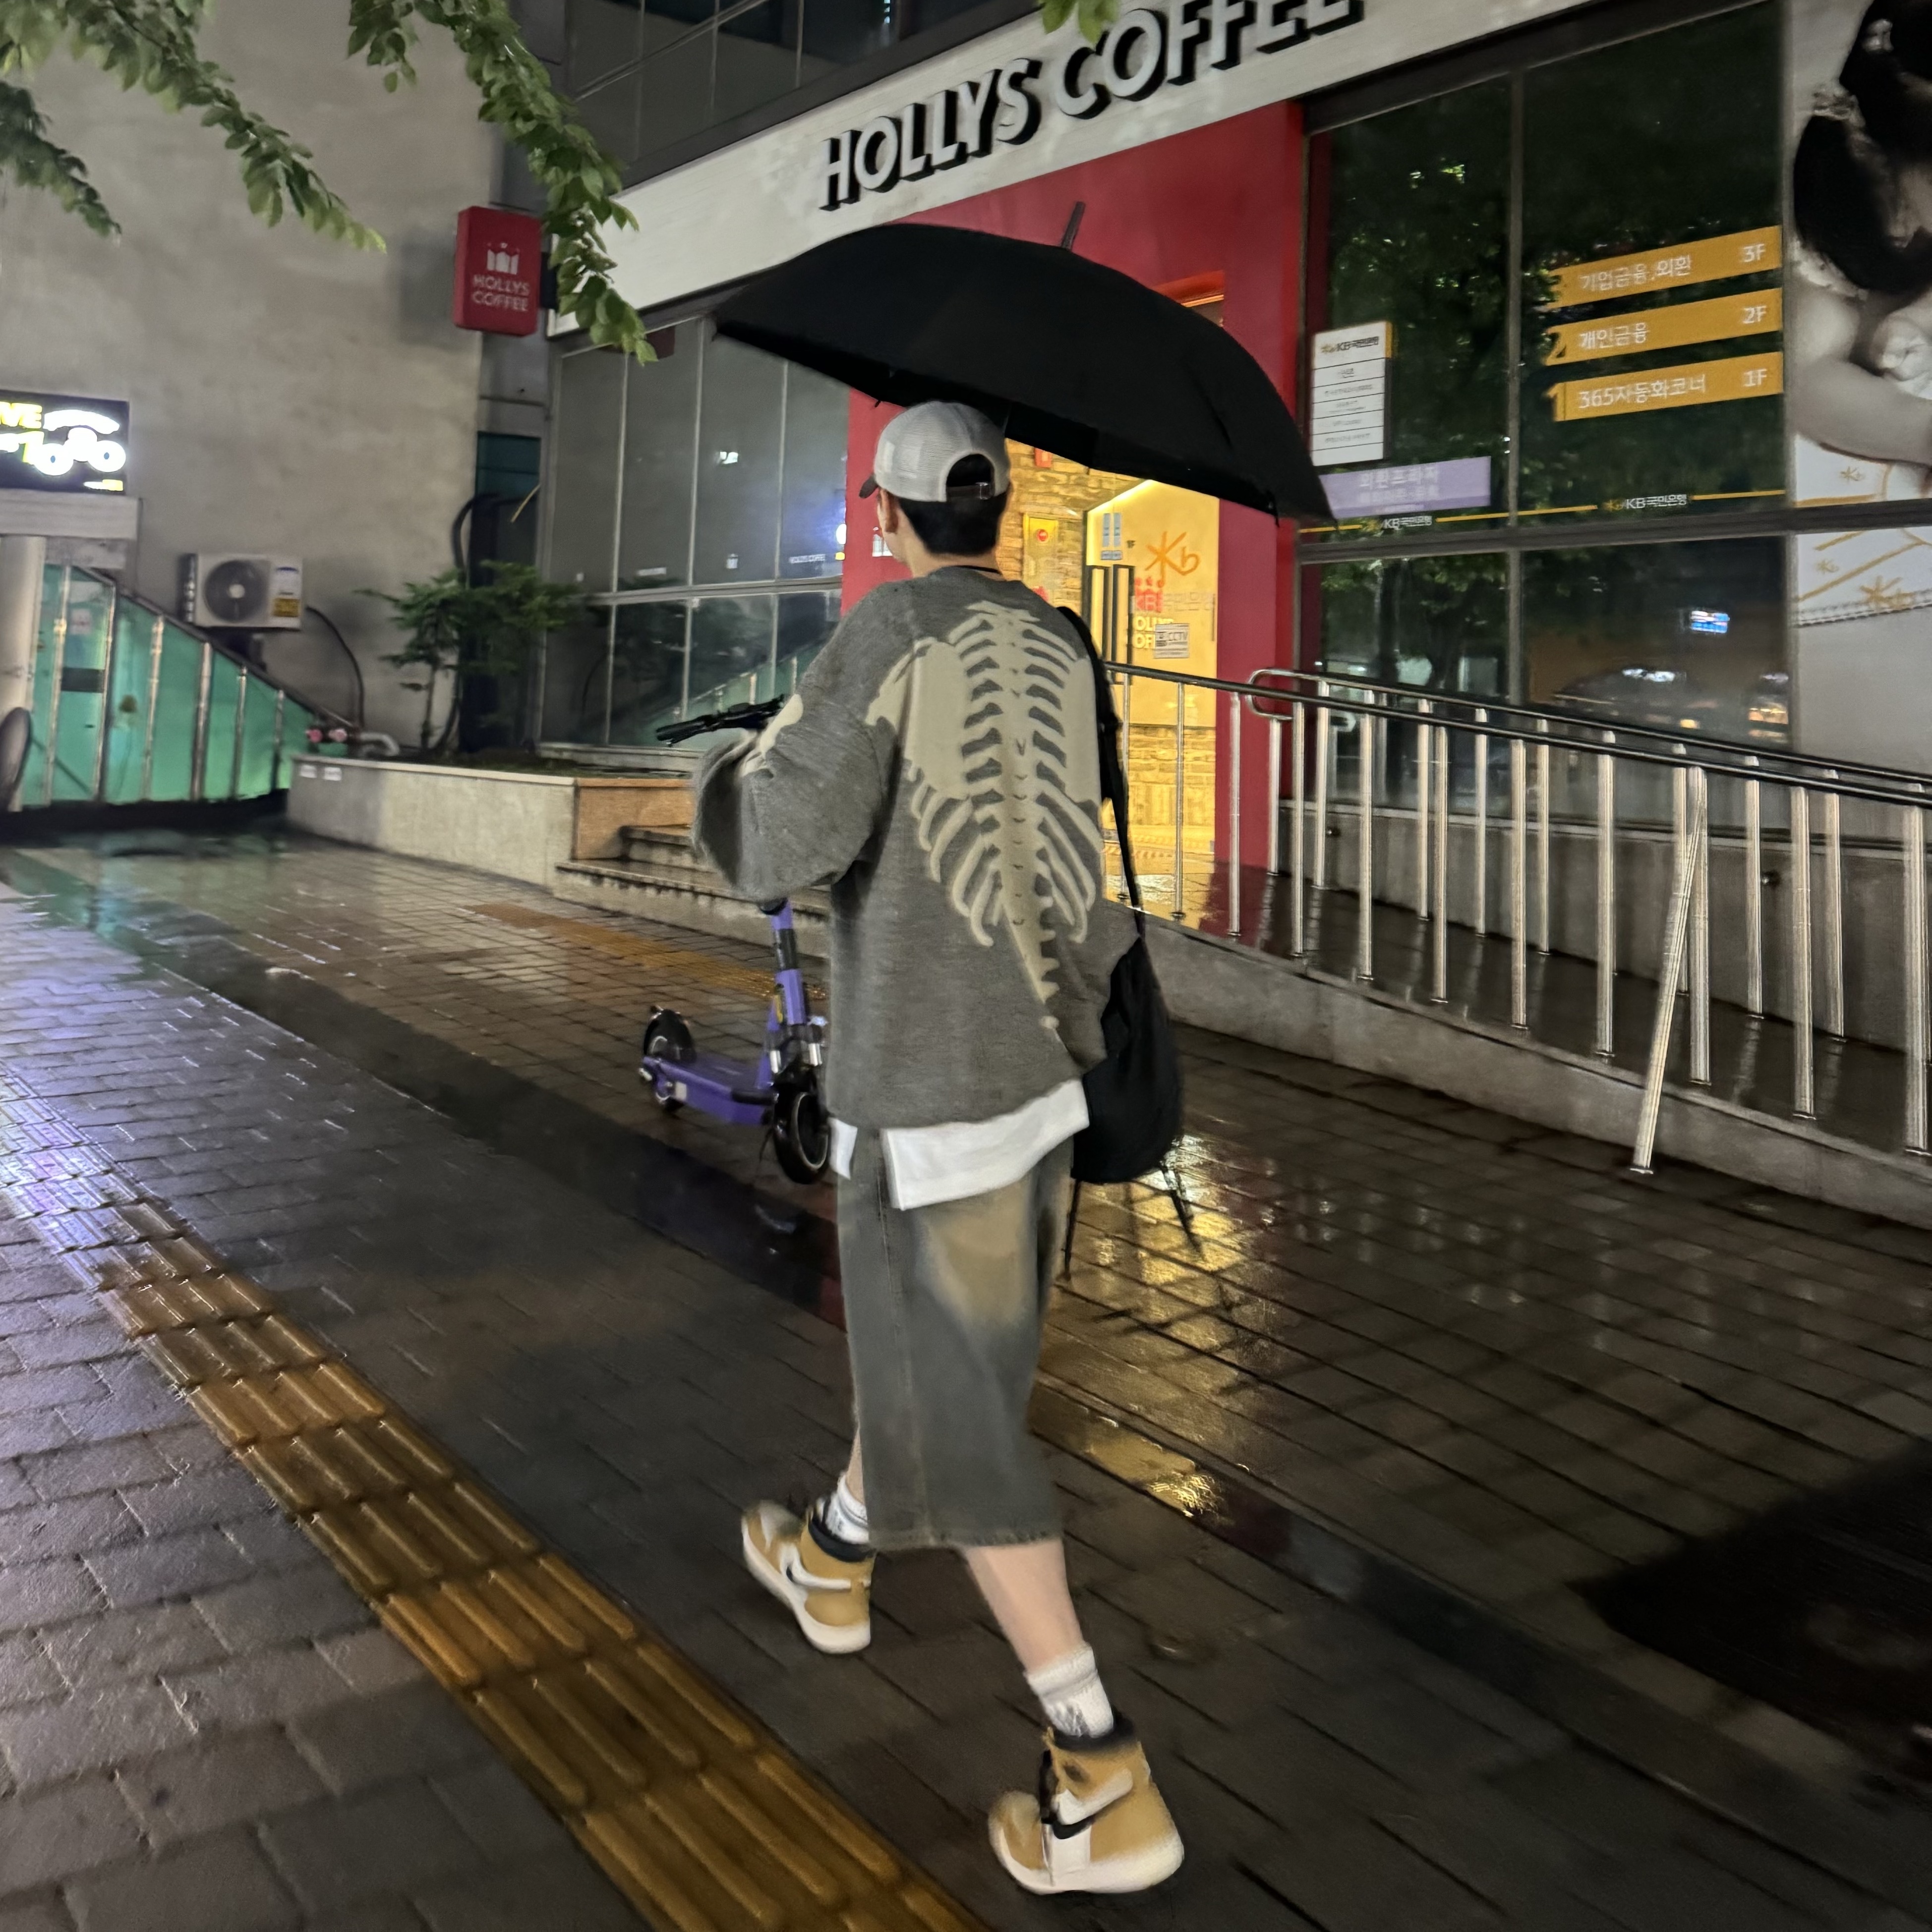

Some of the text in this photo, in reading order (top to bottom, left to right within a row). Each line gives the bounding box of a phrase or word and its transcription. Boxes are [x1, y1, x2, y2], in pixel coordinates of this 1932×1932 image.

[819, 57, 1042, 212] HOLLYS
[1740, 243, 1766, 263] 3F
[472, 274, 530, 296] HOLLYS
[472, 290, 528, 312] COFFEE
[1580, 322, 1650, 349] 개인금융
[1742, 305, 1767, 324] 2F
[1578, 373, 1705, 409] 365자동화코너
[1743, 368, 1767, 387] 1F
